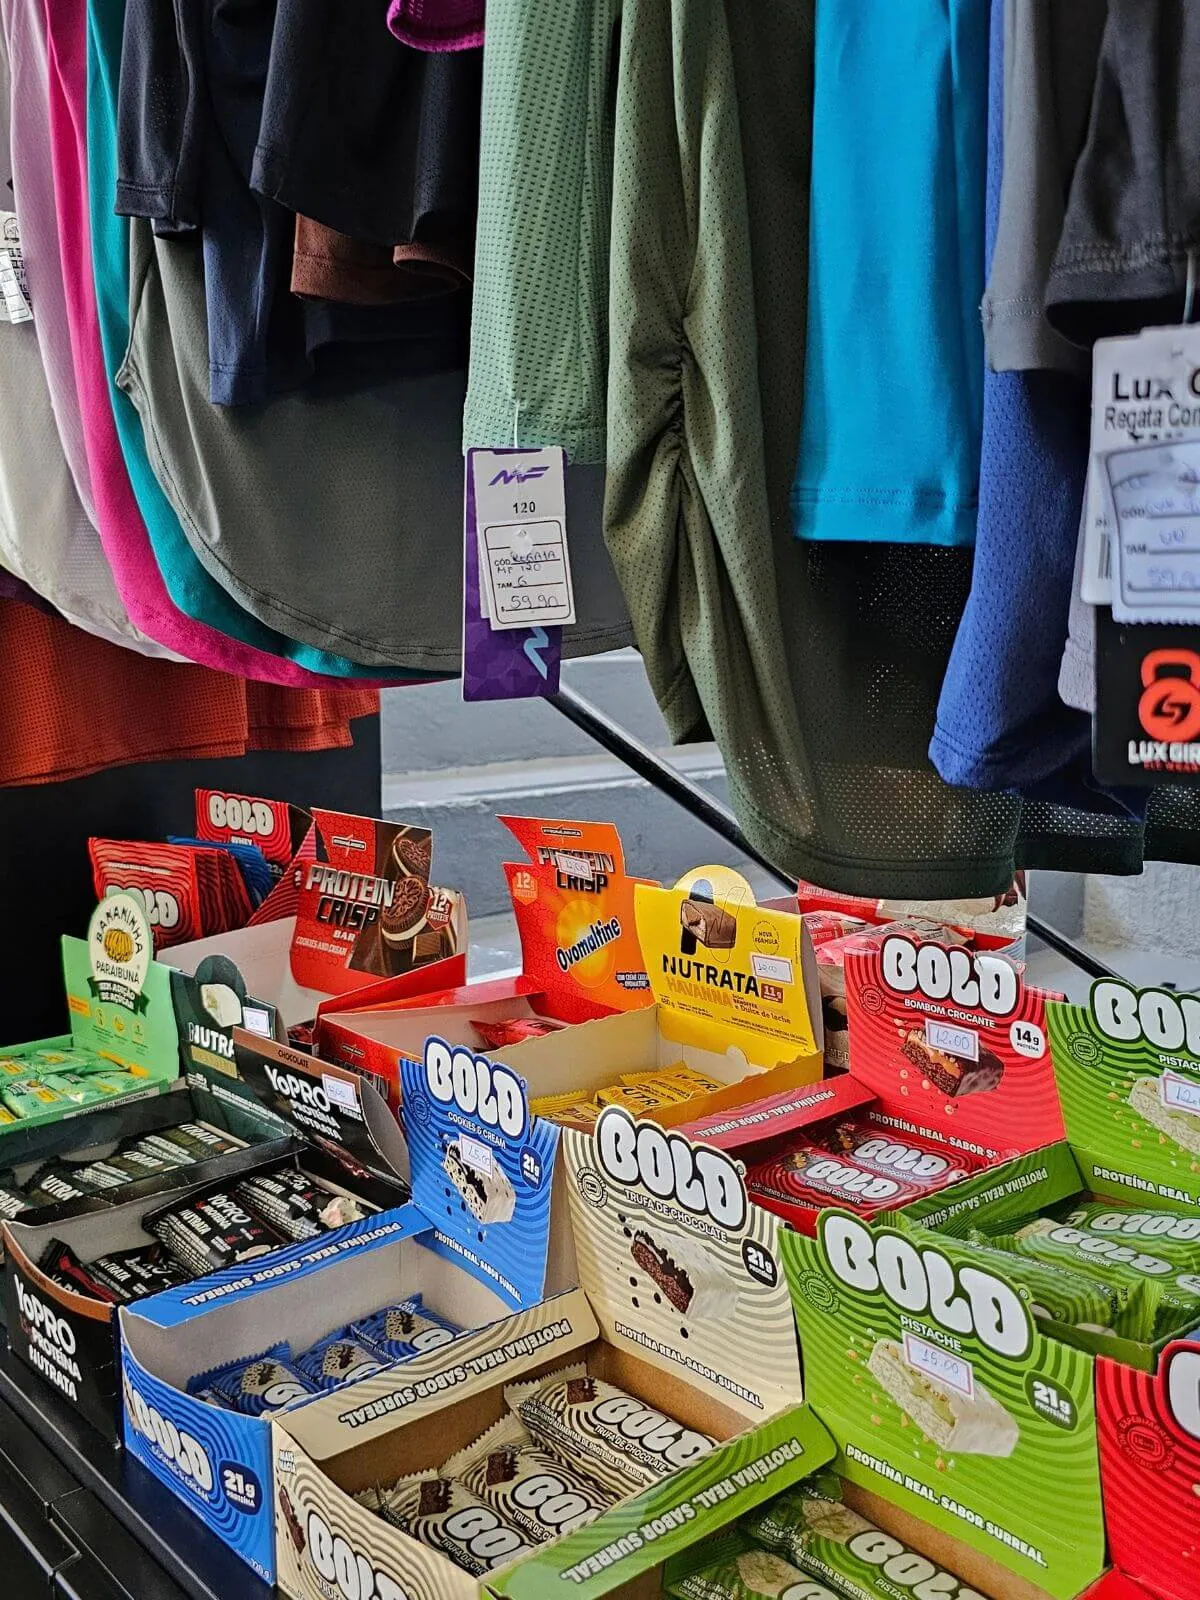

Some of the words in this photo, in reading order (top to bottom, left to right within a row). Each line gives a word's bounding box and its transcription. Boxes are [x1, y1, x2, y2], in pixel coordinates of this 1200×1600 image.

[1104, 405, 1163, 430] Regata
[512, 501, 537, 514] 120
[1128, 740, 1168, 765] LUX
[209, 795, 274, 836] BOLD
[305, 865, 397, 908] PROTEIN
[316, 895, 381, 930] CRISP
[332, 929, 357, 942] BAR
[556, 917, 621, 971] Ovomaltine
[96, 960, 141, 985] PARAIBUNA
[662, 954, 760, 997] NUTRATA
[884, 937, 1017, 1014] BOLD
[904, 998, 946, 1016] BOMBOM
[947, 1007, 997, 1029] CROCANTE
[277, 1049, 310, 1069] CHOCOLATE
[1158, 1054, 1200, 1072] PISTAC
[426, 1041, 525, 1137] BOLD
[794, 1089, 837, 1111] PROTEÍNA
[447, 1111, 477, 1132] COOKIES
[482, 1128, 507, 1149] CREAM
[739, 1109, 770, 1128] SABOR
[869, 1110, 917, 1135] PROTEÍNA
[919, 1126, 949, 1145] REAL.
[949, 1136, 985, 1159] SABOR
[522, 1152, 541, 1176] 21g
[600, 1113, 744, 1228] BOLD
[853, 1139, 949, 1177] BOLD
[805, 1160, 900, 1199] BOLD
[831, 1188, 864, 1205] CROCANTE
[1006, 1167, 1048, 1195] PROTEÍNA
[1093, 1165, 1157, 1194] PROTEÍNA
[1158, 1183, 1196, 1206] REAL.
[353, 1222, 402, 1248] PROTEÍNA
[624, 1188, 656, 1210] TRUFA
[655, 1202, 671, 1218] DE
[669, 1208, 728, 1244] CHOCOLATE
[434, 1231, 464, 1258] PROTEÍNA
[746, 1246, 774, 1275] 21g
[1050, 1226, 1175, 1275] BOLD
[181, 1272, 255, 1306] SURREAL.
[252, 1260, 302, 1283] SABOR
[824, 1215, 1030, 1357] BOLD
[503, 1318, 572, 1357] PROTEÍNA
[899, 1314, 963, 1353] PISTACHE
[28, 1343, 79, 1402] NUTRATA
[415, 1367, 467, 1397] SABOR
[464, 1353, 508, 1377] REAL.
[614, 1321, 660, 1355] PROTEÍNA
[659, 1343, 686, 1367] REAL.
[685, 1355, 718, 1383] SABOR
[717, 1374, 765, 1411] SURREAL.
[338, 1386, 417, 1428] SURREAL.
[1031, 1378, 1072, 1416] 21g
[132, 1389, 213, 1492] BOLD
[593, 1423, 616, 1446] TRUFA
[613, 1436, 627, 1450] DE
[624, 1440, 668, 1474] CHOCOLATE
[594, 1396, 716, 1467] BOLD
[730, 1437, 804, 1489] PROTEÍNA
[223, 1469, 256, 1498] 21g
[691, 1481, 738, 1509] REAL.
[511, 1508, 534, 1531] TRUFA
[531, 1522, 544, 1537] DE
[643, 1501, 697, 1542] SABOR
[846, 1443, 904, 1486] PROTEÍNA
[903, 1475, 940, 1506] REAL.
[939, 1494, 986, 1531] SABOR
[985, 1520, 1049, 1569] SURREAL.
[308, 1512, 411, 1600] BOLD
[440, 1536, 461, 1558] TRUFA
[459, 1550, 473, 1566] DE
[561, 1532, 646, 1584] SURREAL.
[849, 1530, 989, 1600] BOL
[843, 1579, 877, 1600] PROTEÍ
